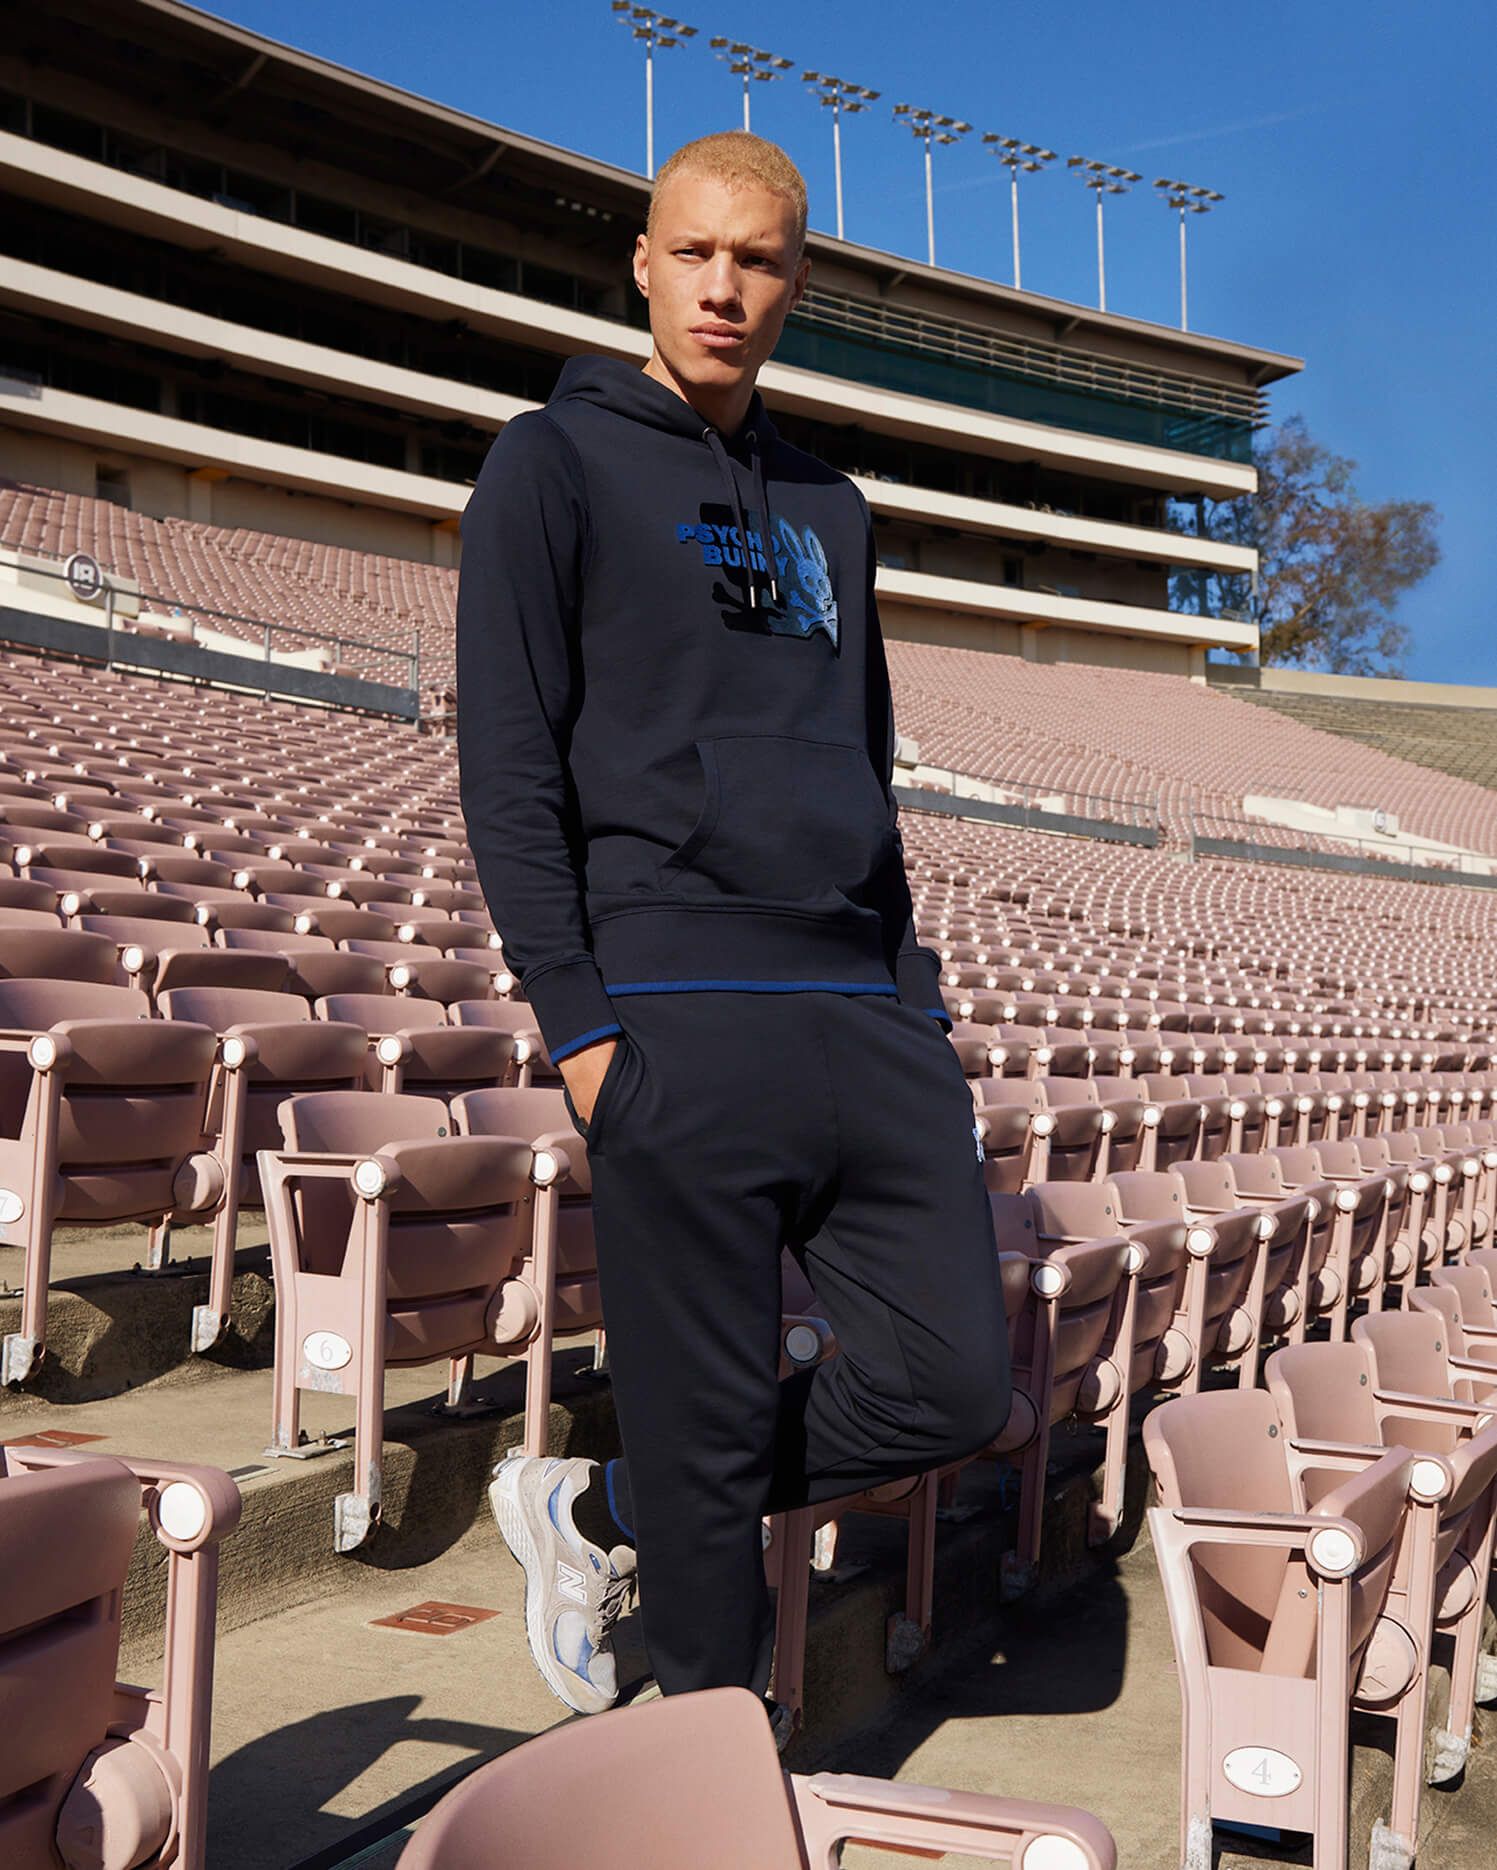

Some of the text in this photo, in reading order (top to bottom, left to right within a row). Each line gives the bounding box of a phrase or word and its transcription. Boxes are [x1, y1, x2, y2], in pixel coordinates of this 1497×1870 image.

[320, 1340, 333, 1361] 6
[557, 1560, 587, 1606] N
[1250, 1758, 1272, 1785] 4
